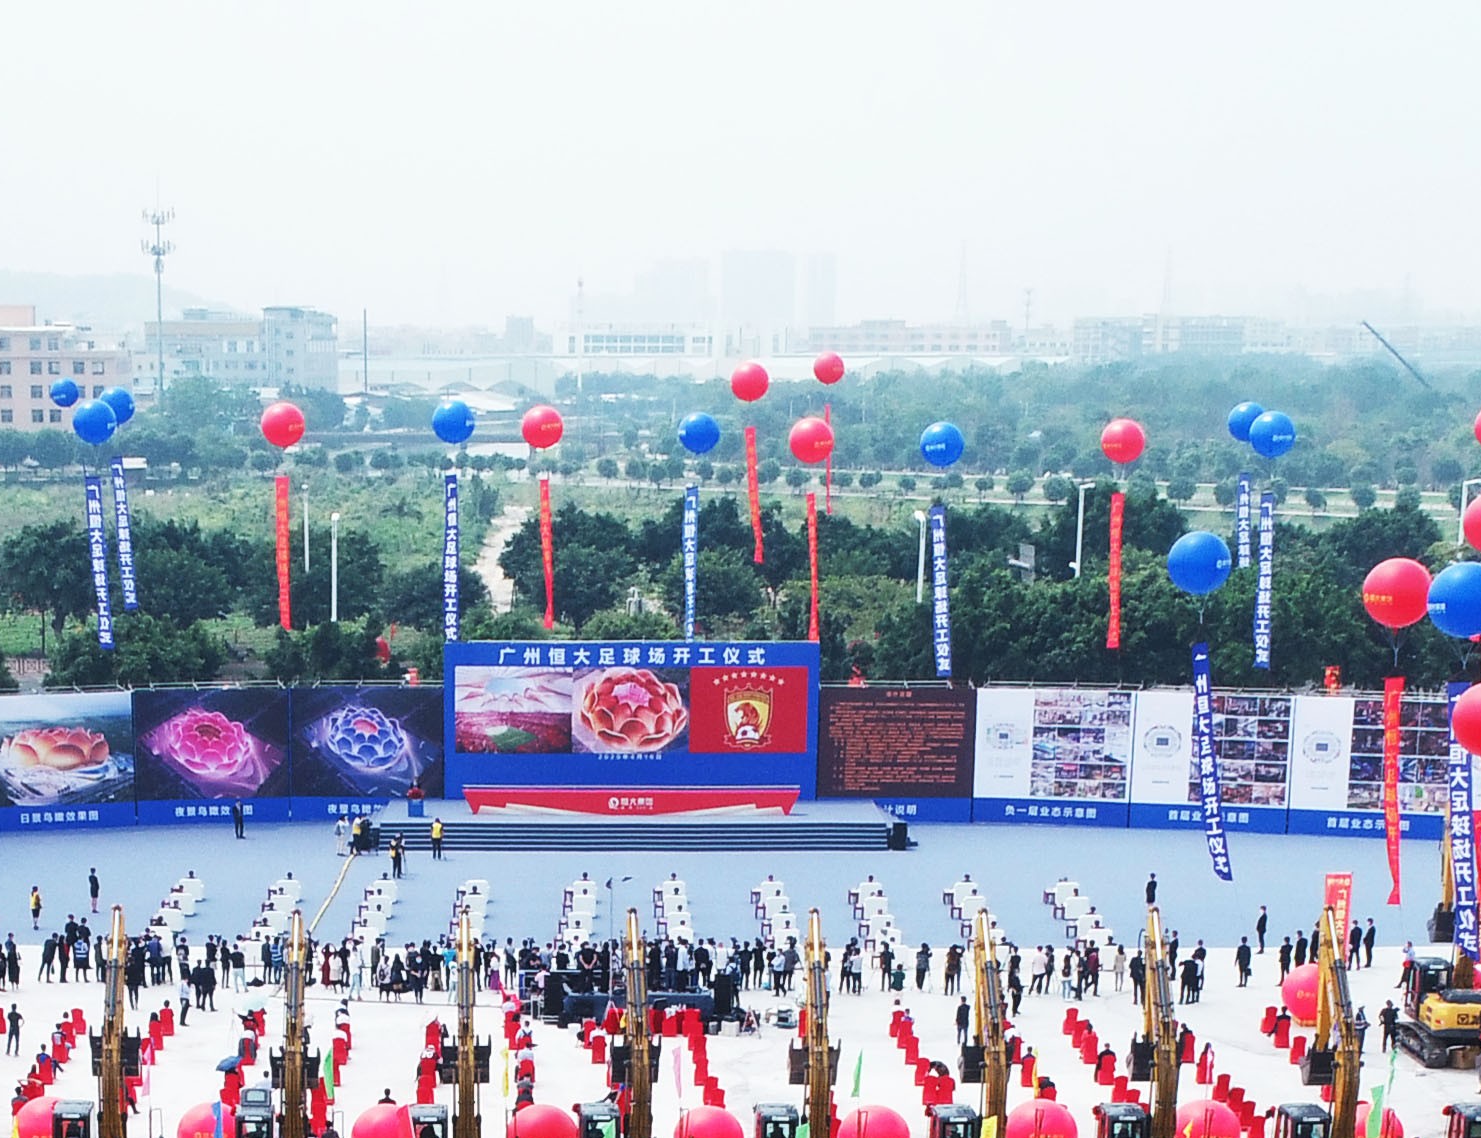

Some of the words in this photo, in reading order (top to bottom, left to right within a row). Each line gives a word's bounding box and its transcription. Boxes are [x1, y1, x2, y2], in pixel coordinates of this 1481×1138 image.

[498, 647, 765, 665] 广州恒大足球场开工仪式
[20, 810, 99, 824] 日景鸟瞰效果图
[175, 804, 253, 817] 夜景鸟瞰效图
[1005, 805, 1097, 819] 负一层业态示意图
[1168, 810, 1249, 823] 首层业意图
[1327, 816, 1410, 831] 首层业态示图
